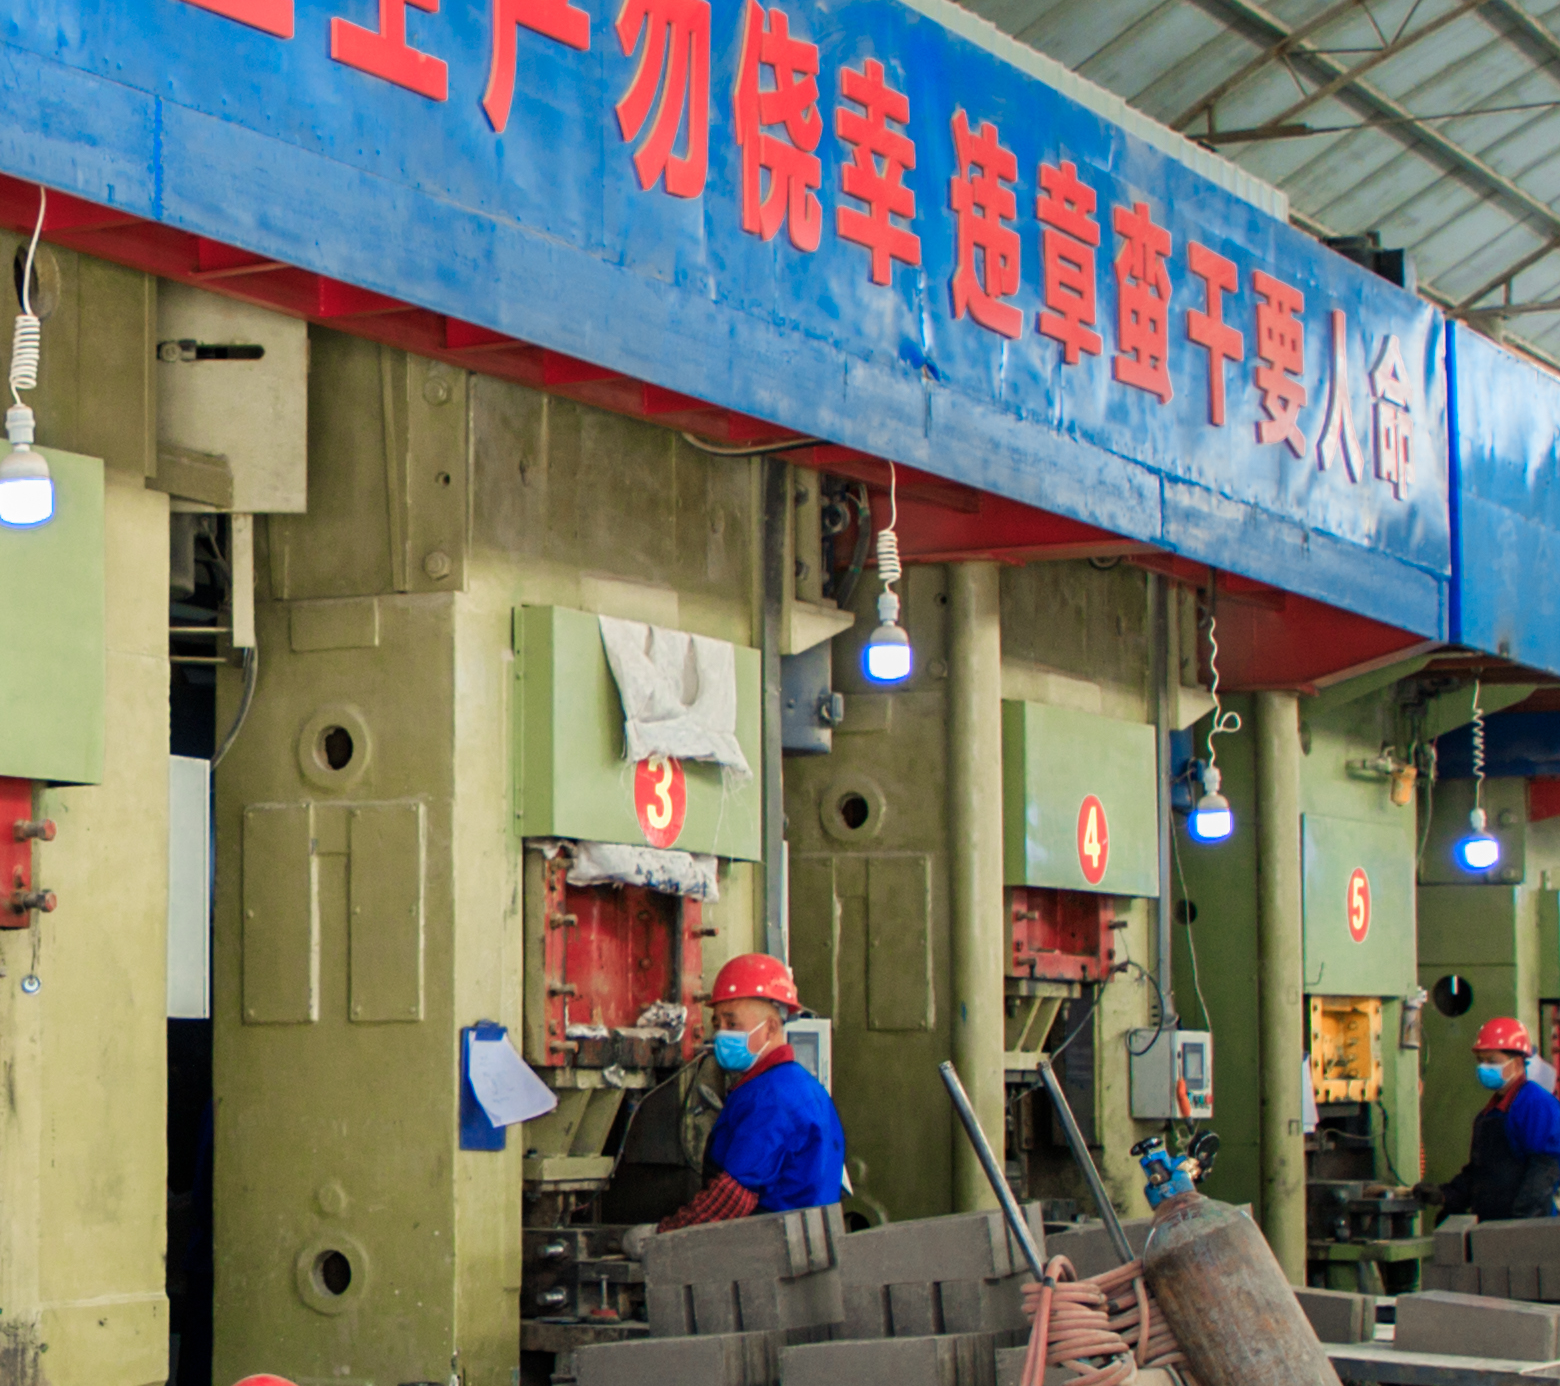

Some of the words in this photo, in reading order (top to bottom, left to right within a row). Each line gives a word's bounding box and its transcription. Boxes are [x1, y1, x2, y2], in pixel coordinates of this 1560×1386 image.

[949, 109, 1415, 501] 违章蛮干要人命
[647, 754, 673, 830] 3
[1084, 806, 1101, 869] 4
[1352, 877, 1365, 931] 5
